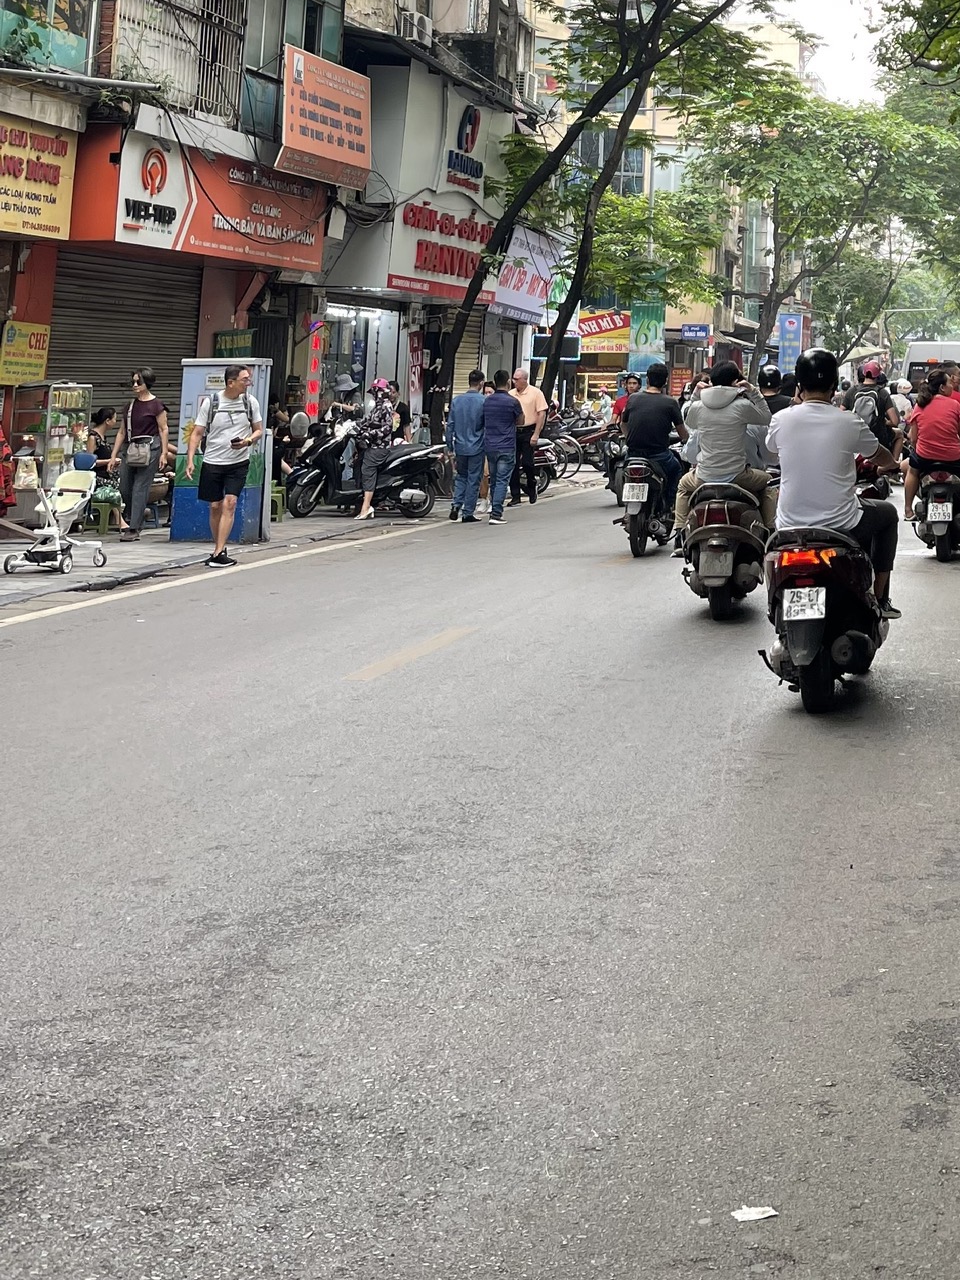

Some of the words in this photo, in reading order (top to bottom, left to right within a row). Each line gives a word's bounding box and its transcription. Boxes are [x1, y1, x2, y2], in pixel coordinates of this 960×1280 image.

[264, 203, 282, 218] HÀNG
[414, 239, 480, 280] HANVIC
[28, 327, 49, 351] CHÈ
[614, 343, 629, 352] 50%
